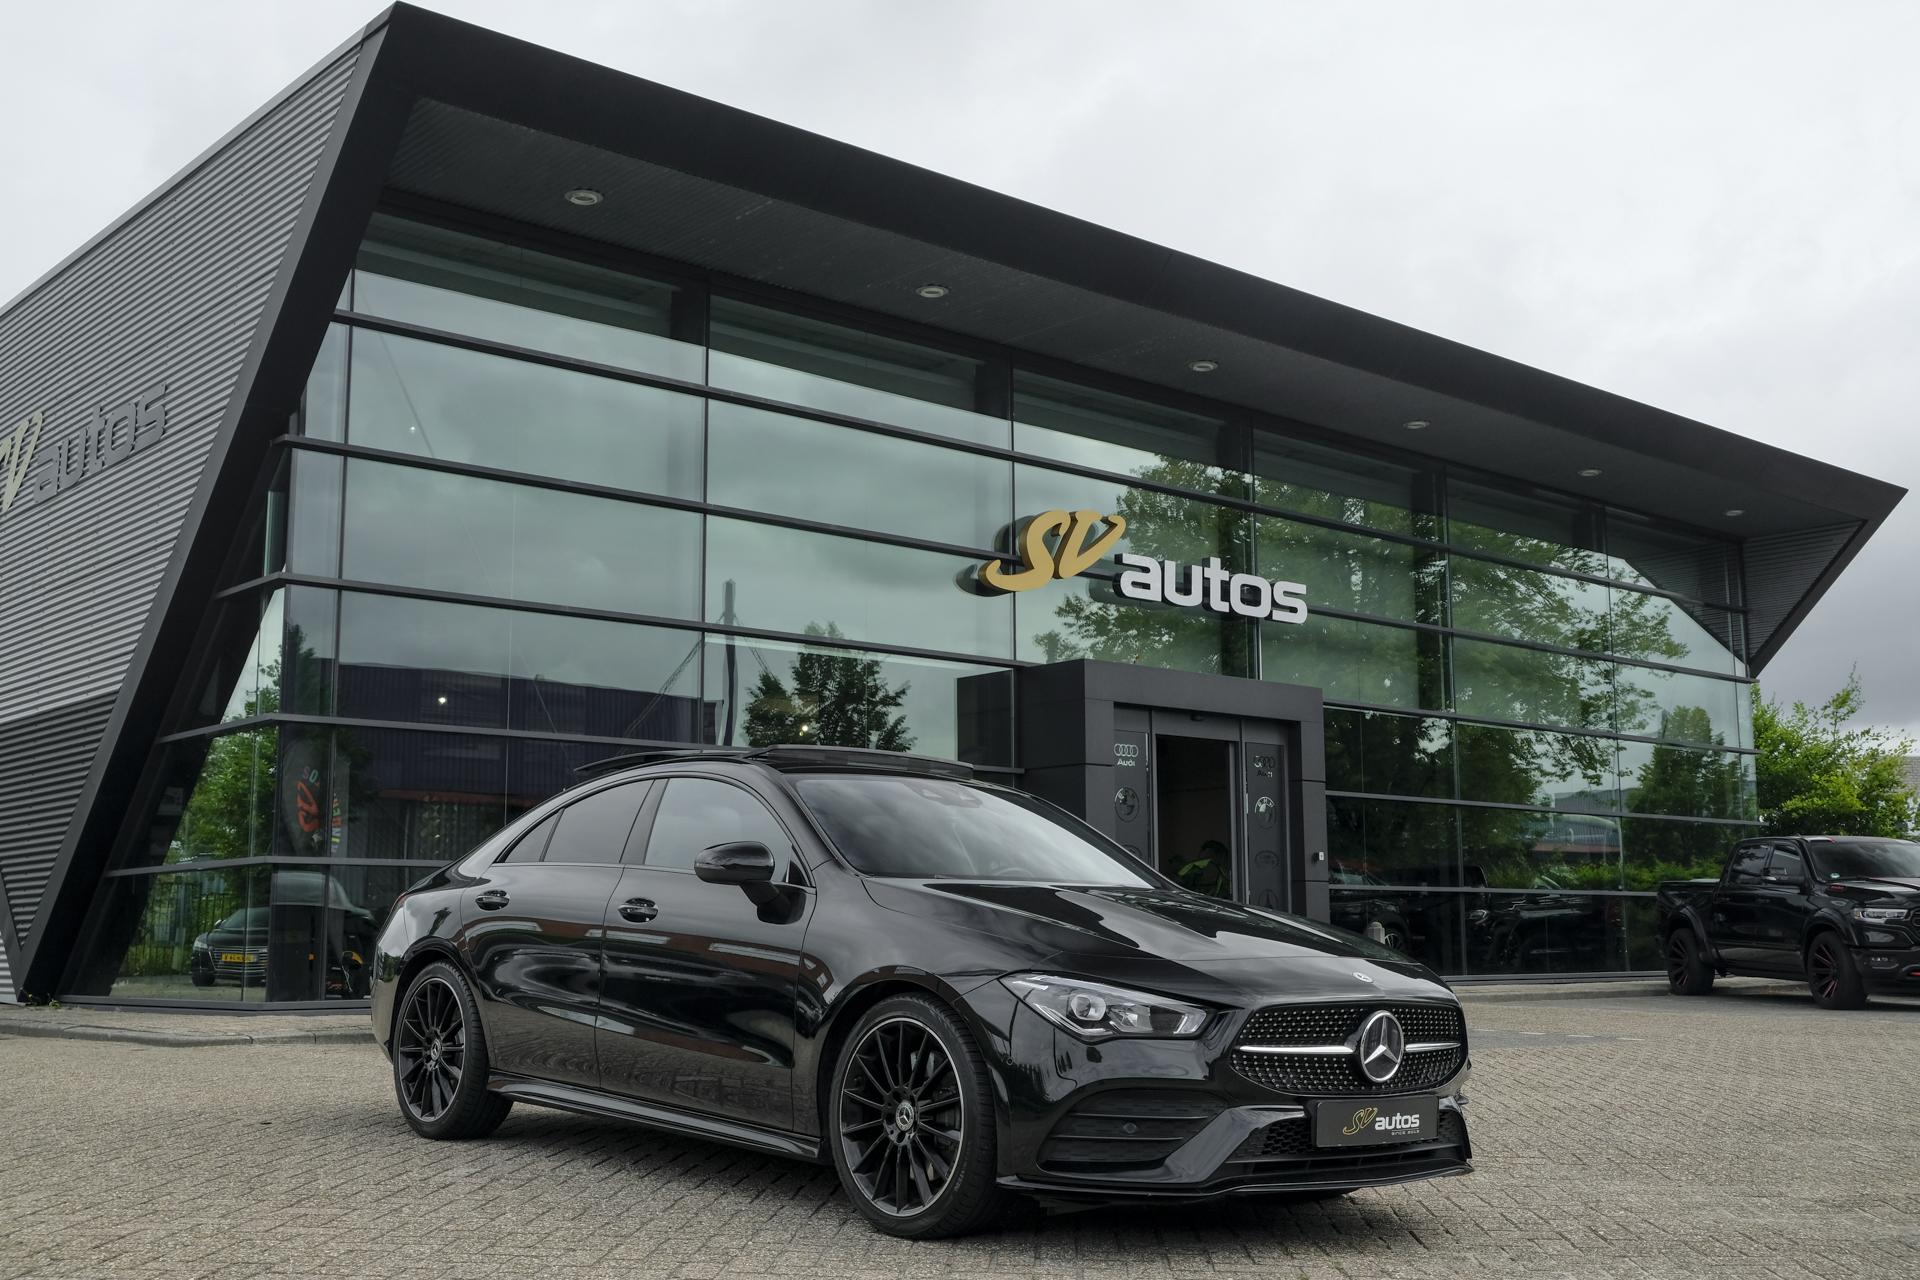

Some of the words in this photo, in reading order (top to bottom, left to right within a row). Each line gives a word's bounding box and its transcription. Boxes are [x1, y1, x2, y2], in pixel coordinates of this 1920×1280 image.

[0, 411, 43, 513] V
[33, 382, 167, 503] autos
[979, 509, 1127, 592] SV
[1115, 553, 1308, 625] autos
[1117, 758, 1136, 767] Audi
[1342, 1107, 1378, 1135] SV
[1374, 1112, 1420, 1130] autos
